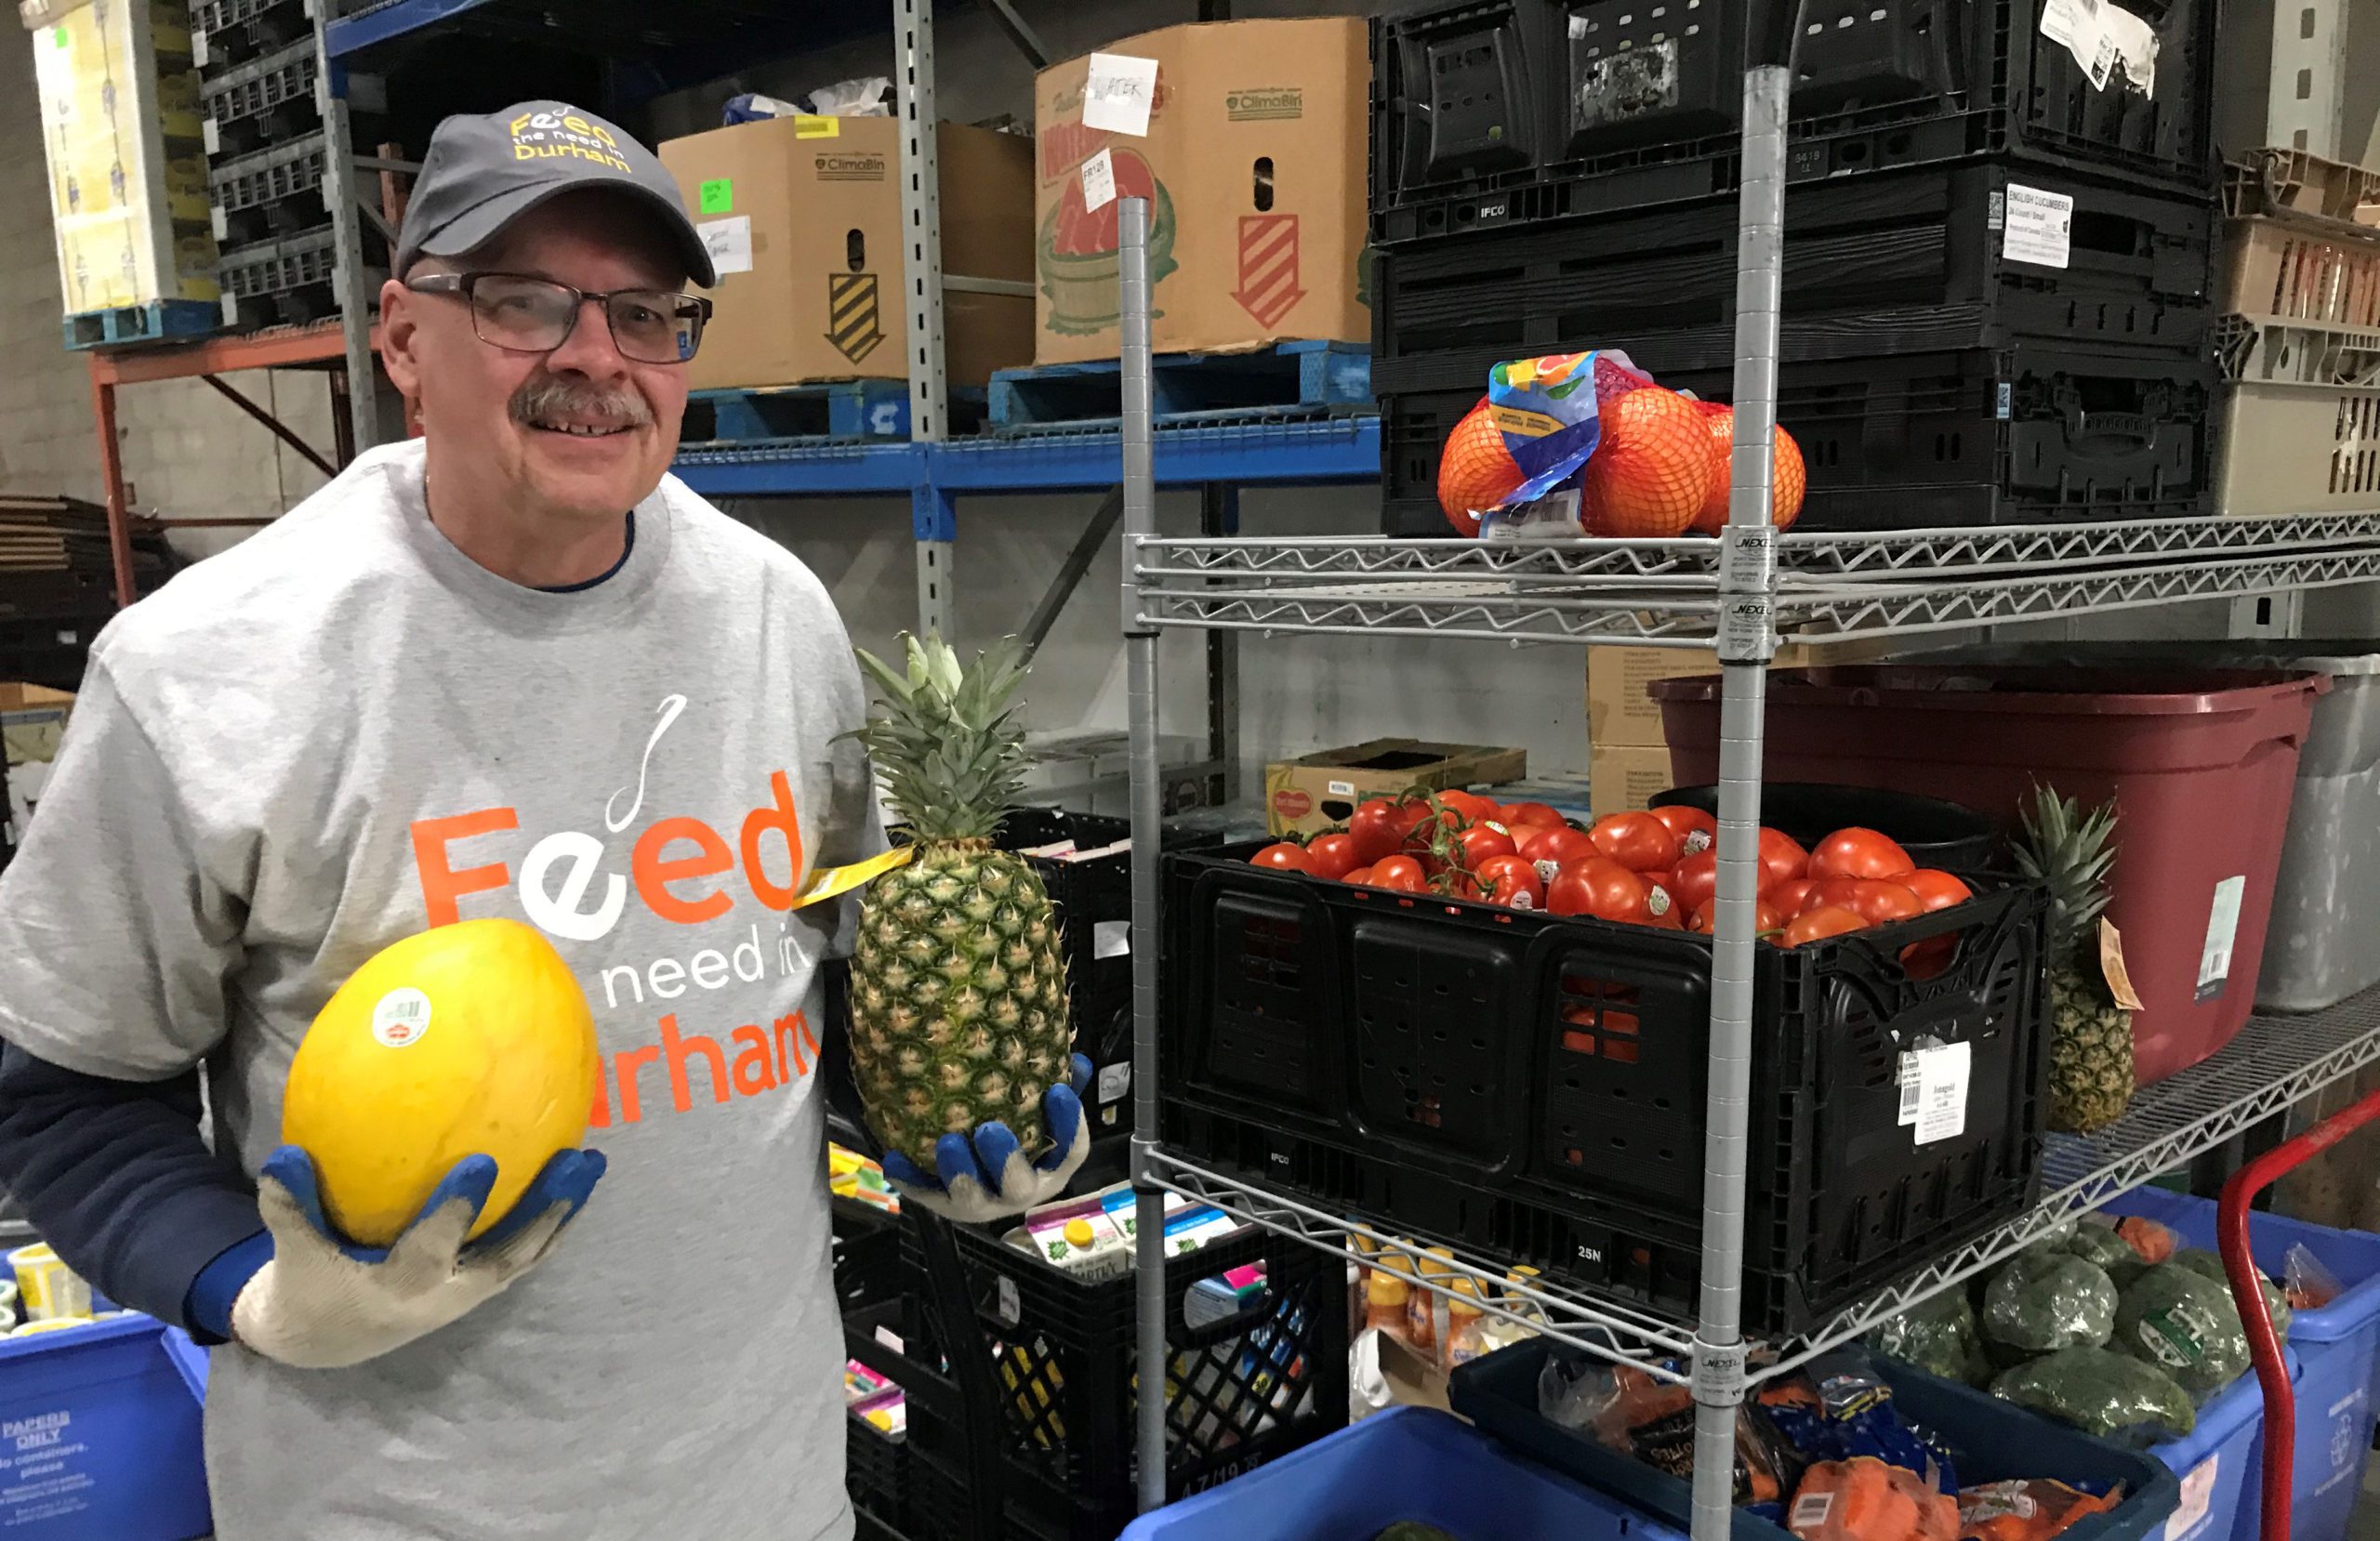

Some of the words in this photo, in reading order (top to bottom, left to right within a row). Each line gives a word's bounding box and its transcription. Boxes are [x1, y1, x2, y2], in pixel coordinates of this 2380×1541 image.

[1240, 93, 1302, 109] ClimaBin
[509, 112, 617, 149] Feed
[512, 132, 545, 145] the
[552, 130, 602, 150] need
[607, 143, 625, 160] in
[513, 142, 632, 174] Durham
[827, 158, 886, 171] ClimaBin
[1480, 204, 1505, 218] IFCO
[2008, 190, 2034, 204] ENGLISH
[2034, 196, 2070, 212] CUCUMBERS
[1731, 605, 1773, 614] NEXEL
[410, 770, 806, 942] Feed
[601, 923, 767, 1009] need
[778, 922, 813, 977] in
[1271, 1152, 1289, 1165] IFCO
[1578, 1245, 1601, 1263] 25N
[3, 1411, 70, 1438] PAPERS
[17, 1429, 61, 1450] ONLY
[20, 1461, 64, 1480] please
